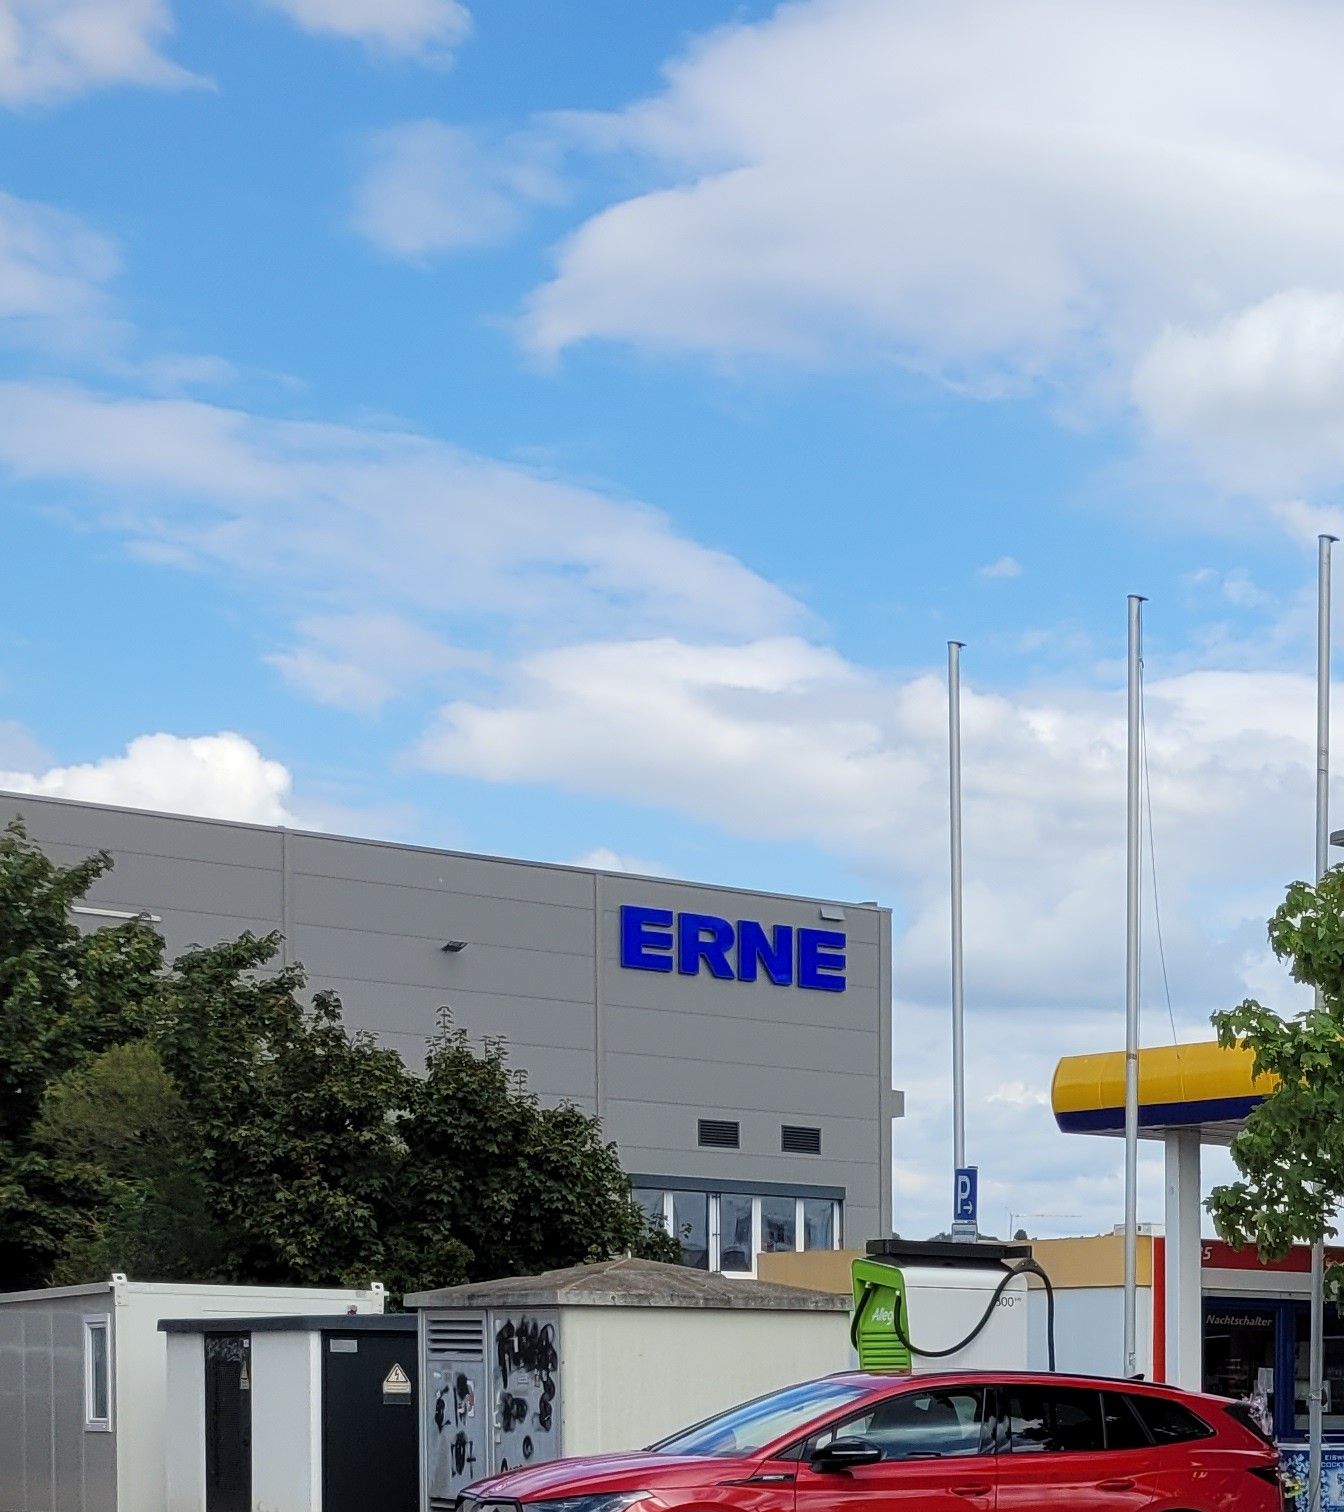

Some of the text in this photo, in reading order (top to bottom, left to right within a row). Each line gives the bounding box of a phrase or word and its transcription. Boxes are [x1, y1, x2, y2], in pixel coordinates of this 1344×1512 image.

[620, 905, 846, 992] ERNE
[957, 1175, 971, 1214] P
[871, 1307, 894, 1326] Alleg
[1205, 1314, 1273, 1328] Nachtschalter
